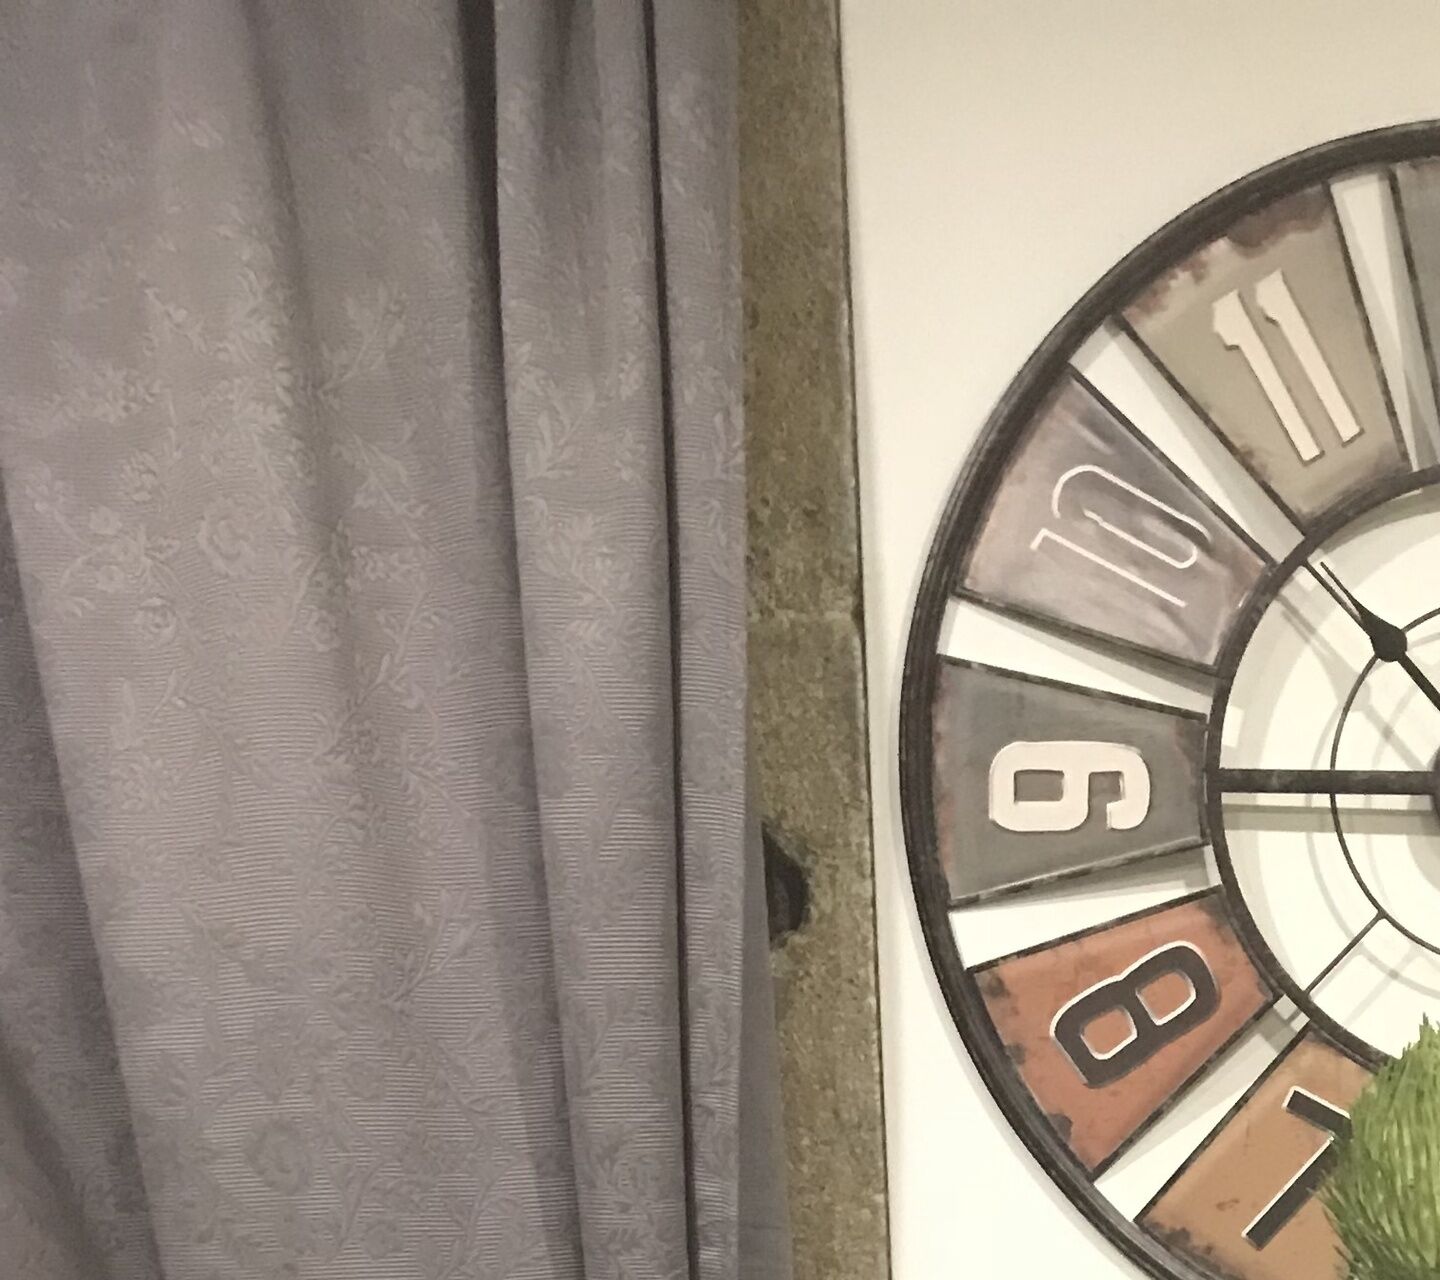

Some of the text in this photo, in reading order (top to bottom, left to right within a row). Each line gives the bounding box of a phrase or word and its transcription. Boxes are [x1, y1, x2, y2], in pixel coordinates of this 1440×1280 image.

[1212, 270, 1366, 464] 11
[1029, 464, 1213, 608] 10
[988, 740, 1152, 832] 9
[1048, 940, 1222, 1088] 8
